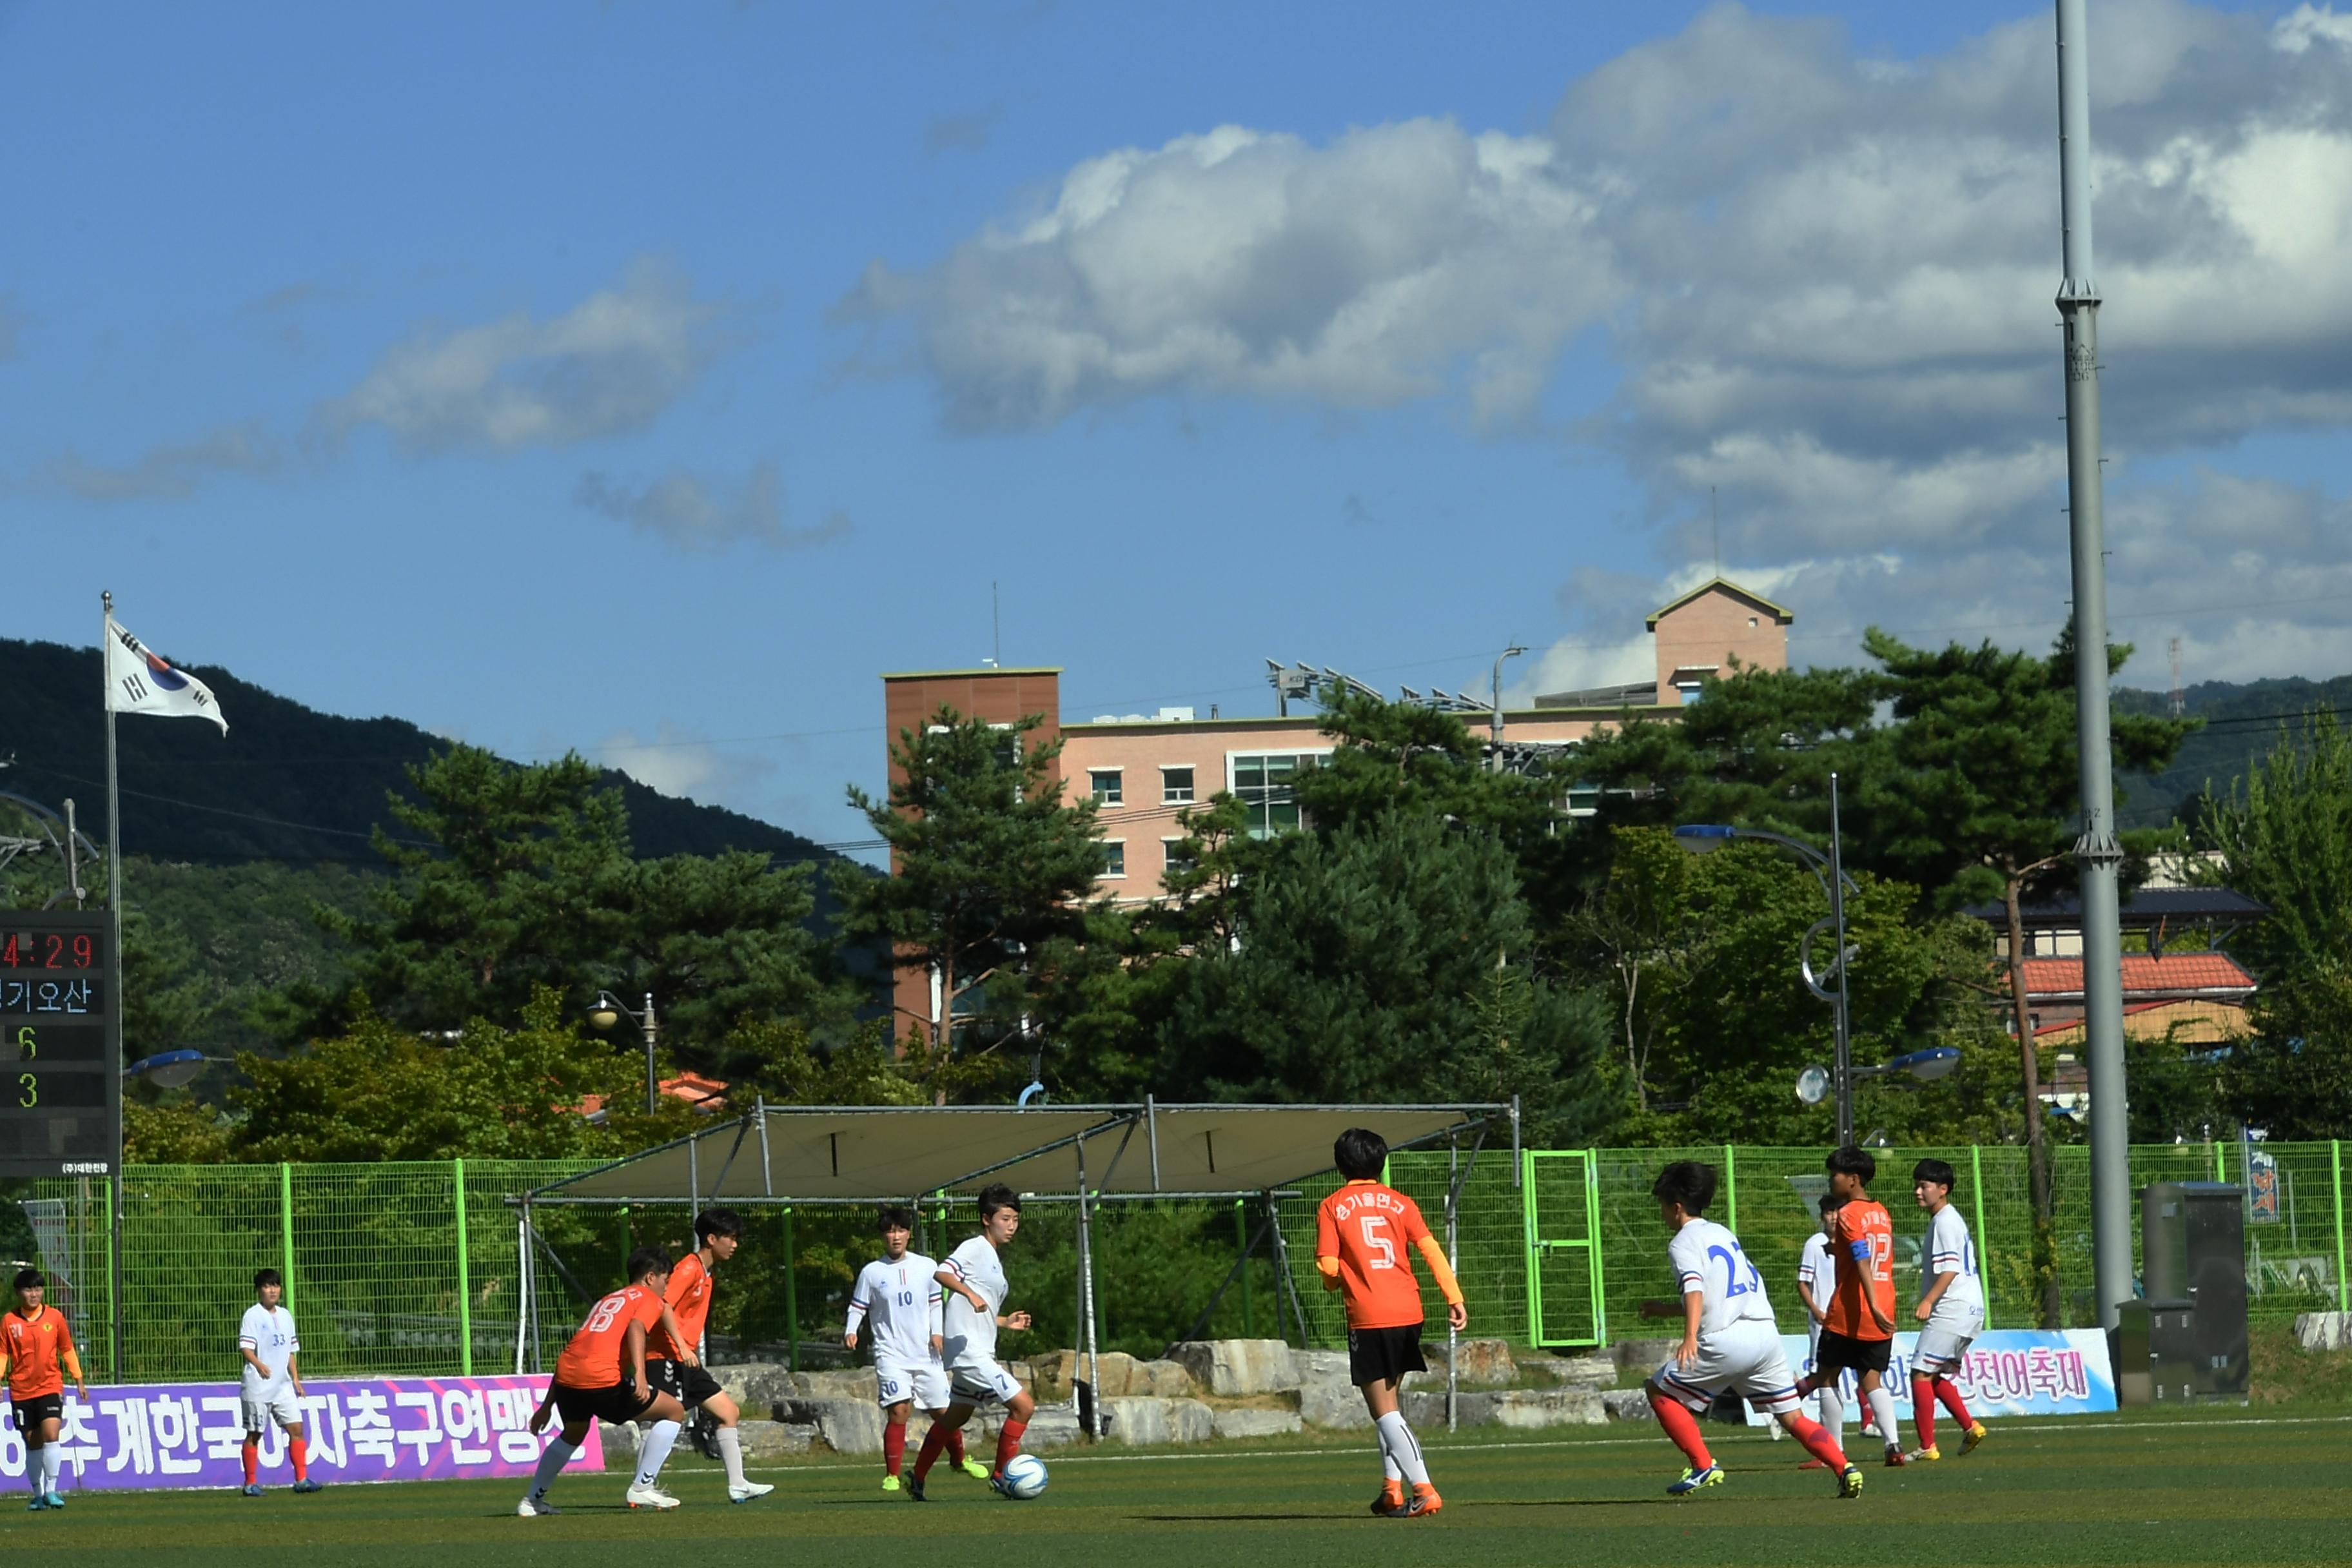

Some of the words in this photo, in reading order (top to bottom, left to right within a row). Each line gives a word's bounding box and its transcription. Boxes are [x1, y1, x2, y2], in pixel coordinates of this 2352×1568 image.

[4, 934, 92, 968] 4:29
[0, 979, 92, 1013] 기오산
[18, 1026, 36, 1059] 6
[19, 1073, 37, 1107] 3
[1360, 1216, 1395, 1269] 5
[1865, 1233, 1892, 1281] 12
[897, 1291, 913, 1307] 10
[273, 1334, 286, 1347] 33
[995, 1374, 1009, 1391] 7
